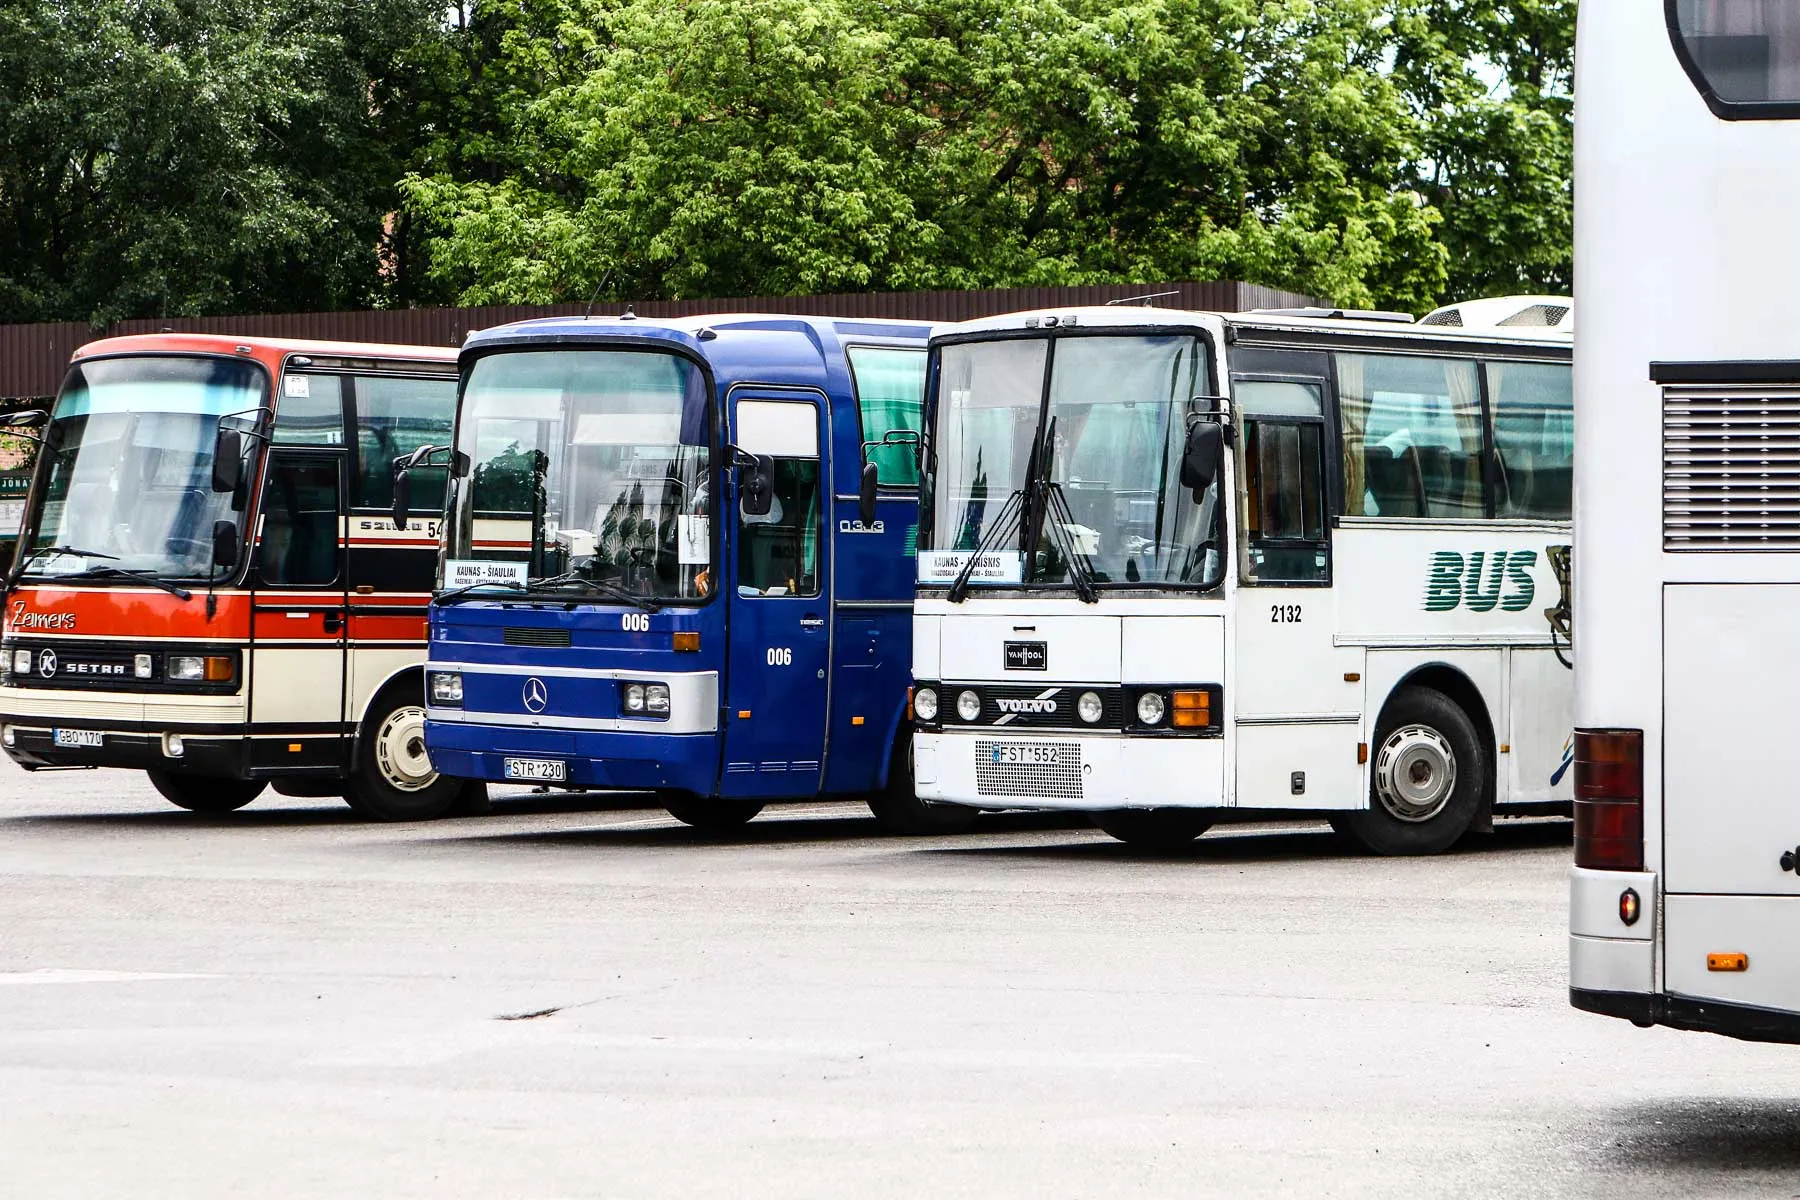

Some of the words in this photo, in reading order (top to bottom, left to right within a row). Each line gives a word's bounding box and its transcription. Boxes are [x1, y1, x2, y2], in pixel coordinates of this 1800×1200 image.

[2, 479, 32, 488] JONA
[933, 556, 959, 568] KAUNAS
[456, 566, 481, 577] KAUNAS
[487, 564, 517, 578] ŠIAULIAI
[1420, 550, 1537, 613] BUS
[1271, 604, 1302, 623] 2132
[622, 613, 649, 632] 006
[767, 647, 792, 666] 006
[66, 663, 125, 674] SETRA
[996, 699, 1057, 713] VOLVO
[85, 731, 101, 745] 170
[1000, 747, 1026, 761] FST
[1034, 748, 1057, 762] 552
[512, 761, 535, 776] STR
[542, 763, 561, 777] 230
